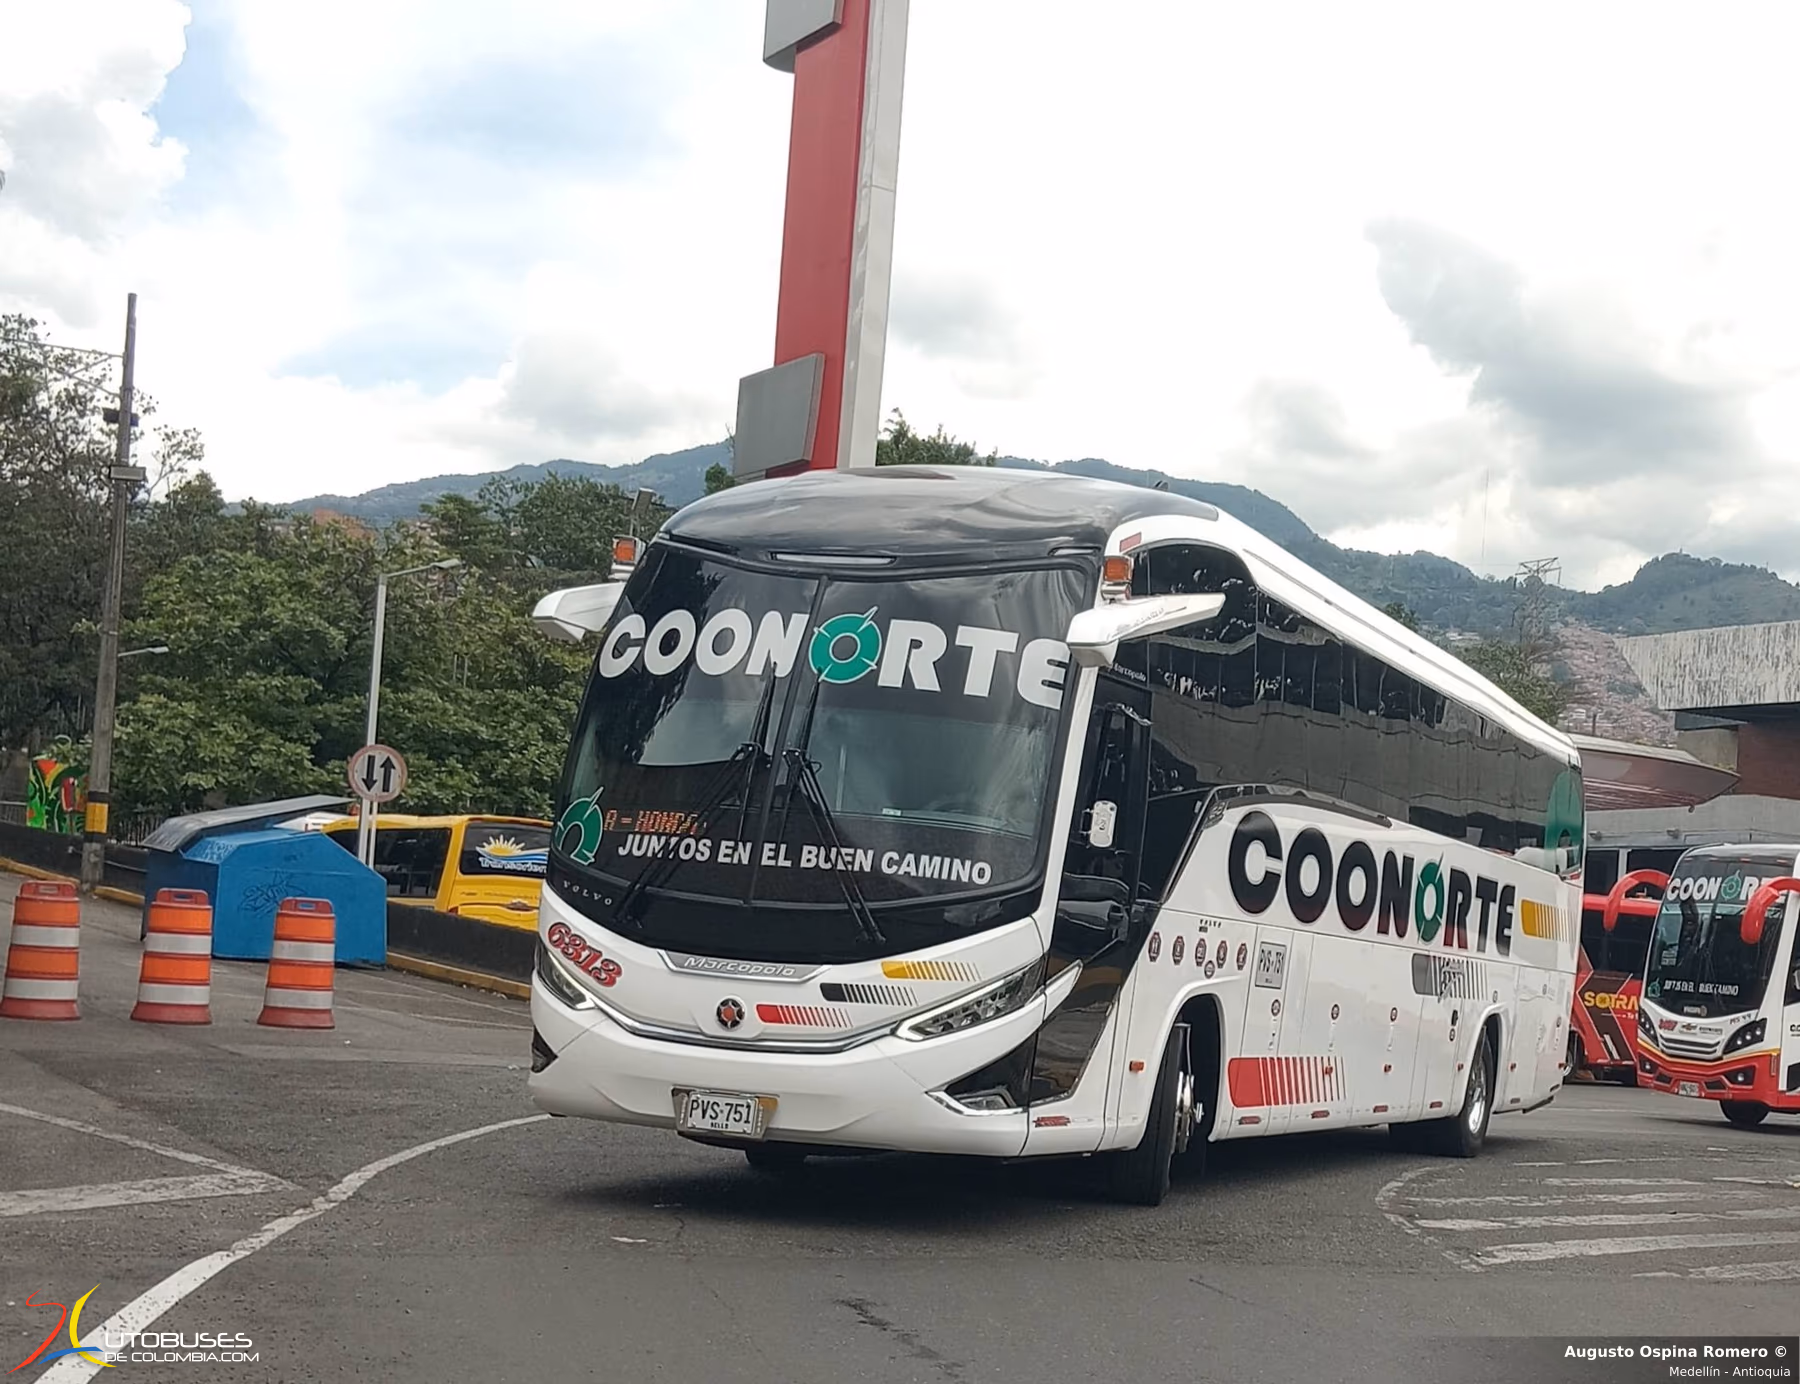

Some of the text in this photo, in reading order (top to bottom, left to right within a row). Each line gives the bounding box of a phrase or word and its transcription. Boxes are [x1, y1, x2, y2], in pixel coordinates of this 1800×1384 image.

[599, 607, 1069, 710] COONORTE
[717, 840, 752, 864] EN
[761, 843, 792, 867] EL
[800, 845, 874, 872] BUEN
[881, 851, 992, 885] CAMINO
[1228, 810, 1517, 957] COONORTE
[563, 880, 613, 905] VOLVO
[547, 921, 623, 988] 6313
[684, 956, 796, 976] Marcopolo
